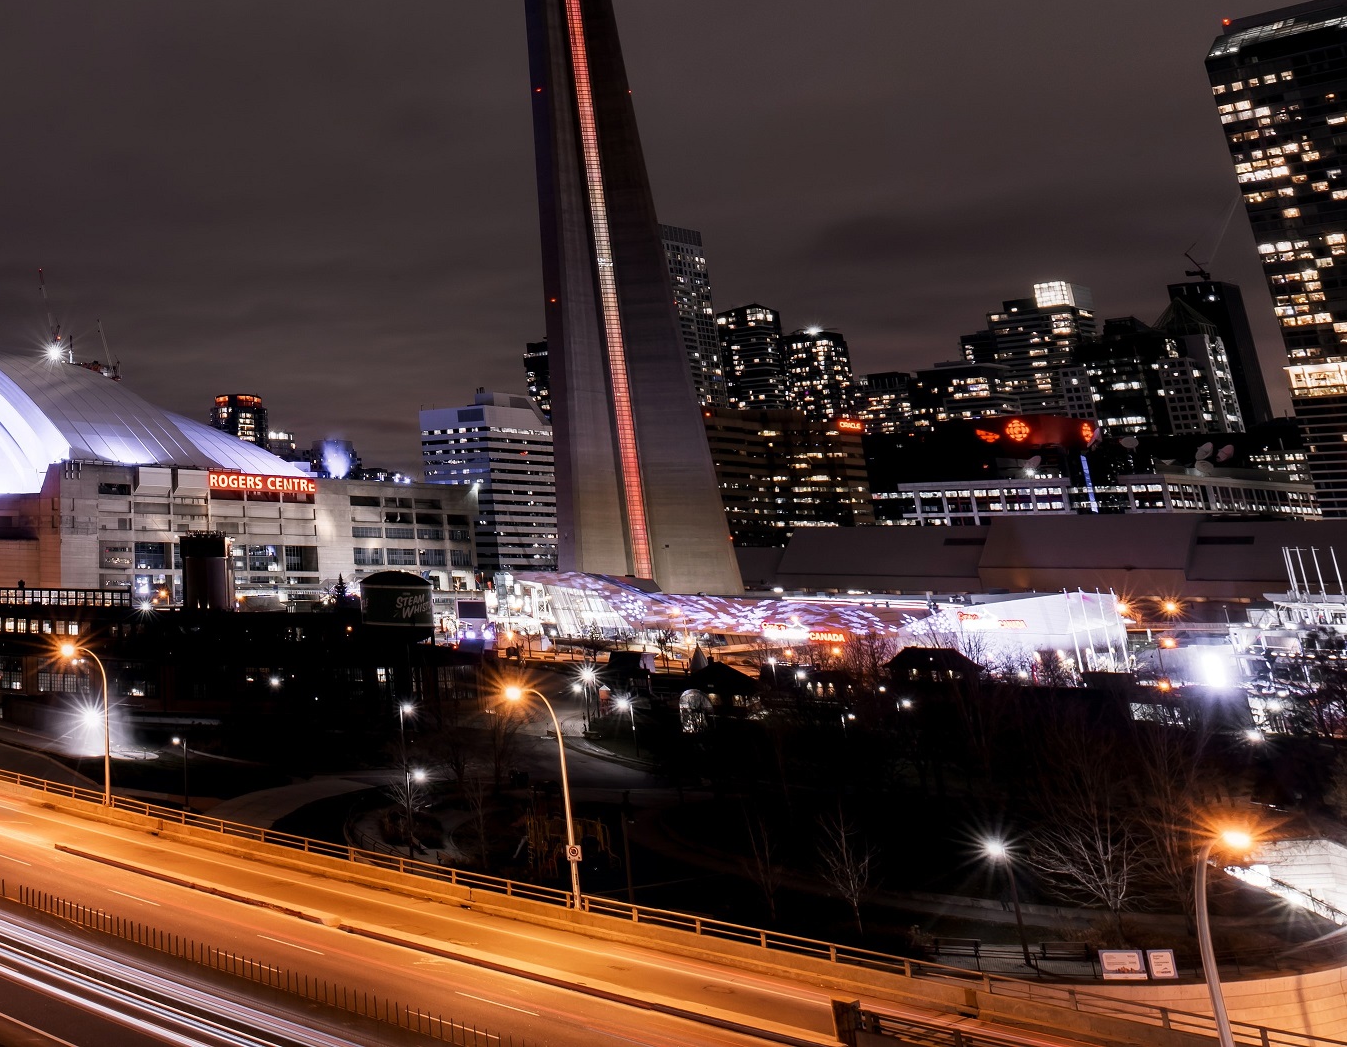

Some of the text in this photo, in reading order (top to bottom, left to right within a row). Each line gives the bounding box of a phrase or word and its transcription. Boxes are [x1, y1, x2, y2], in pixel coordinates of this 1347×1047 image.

[840, 421, 861, 429] ORACLE
[209, 474, 315, 492] ROGERS CENTRE
[395, 593, 425, 609] STEAM
[809, 632, 845, 642] CANADA
